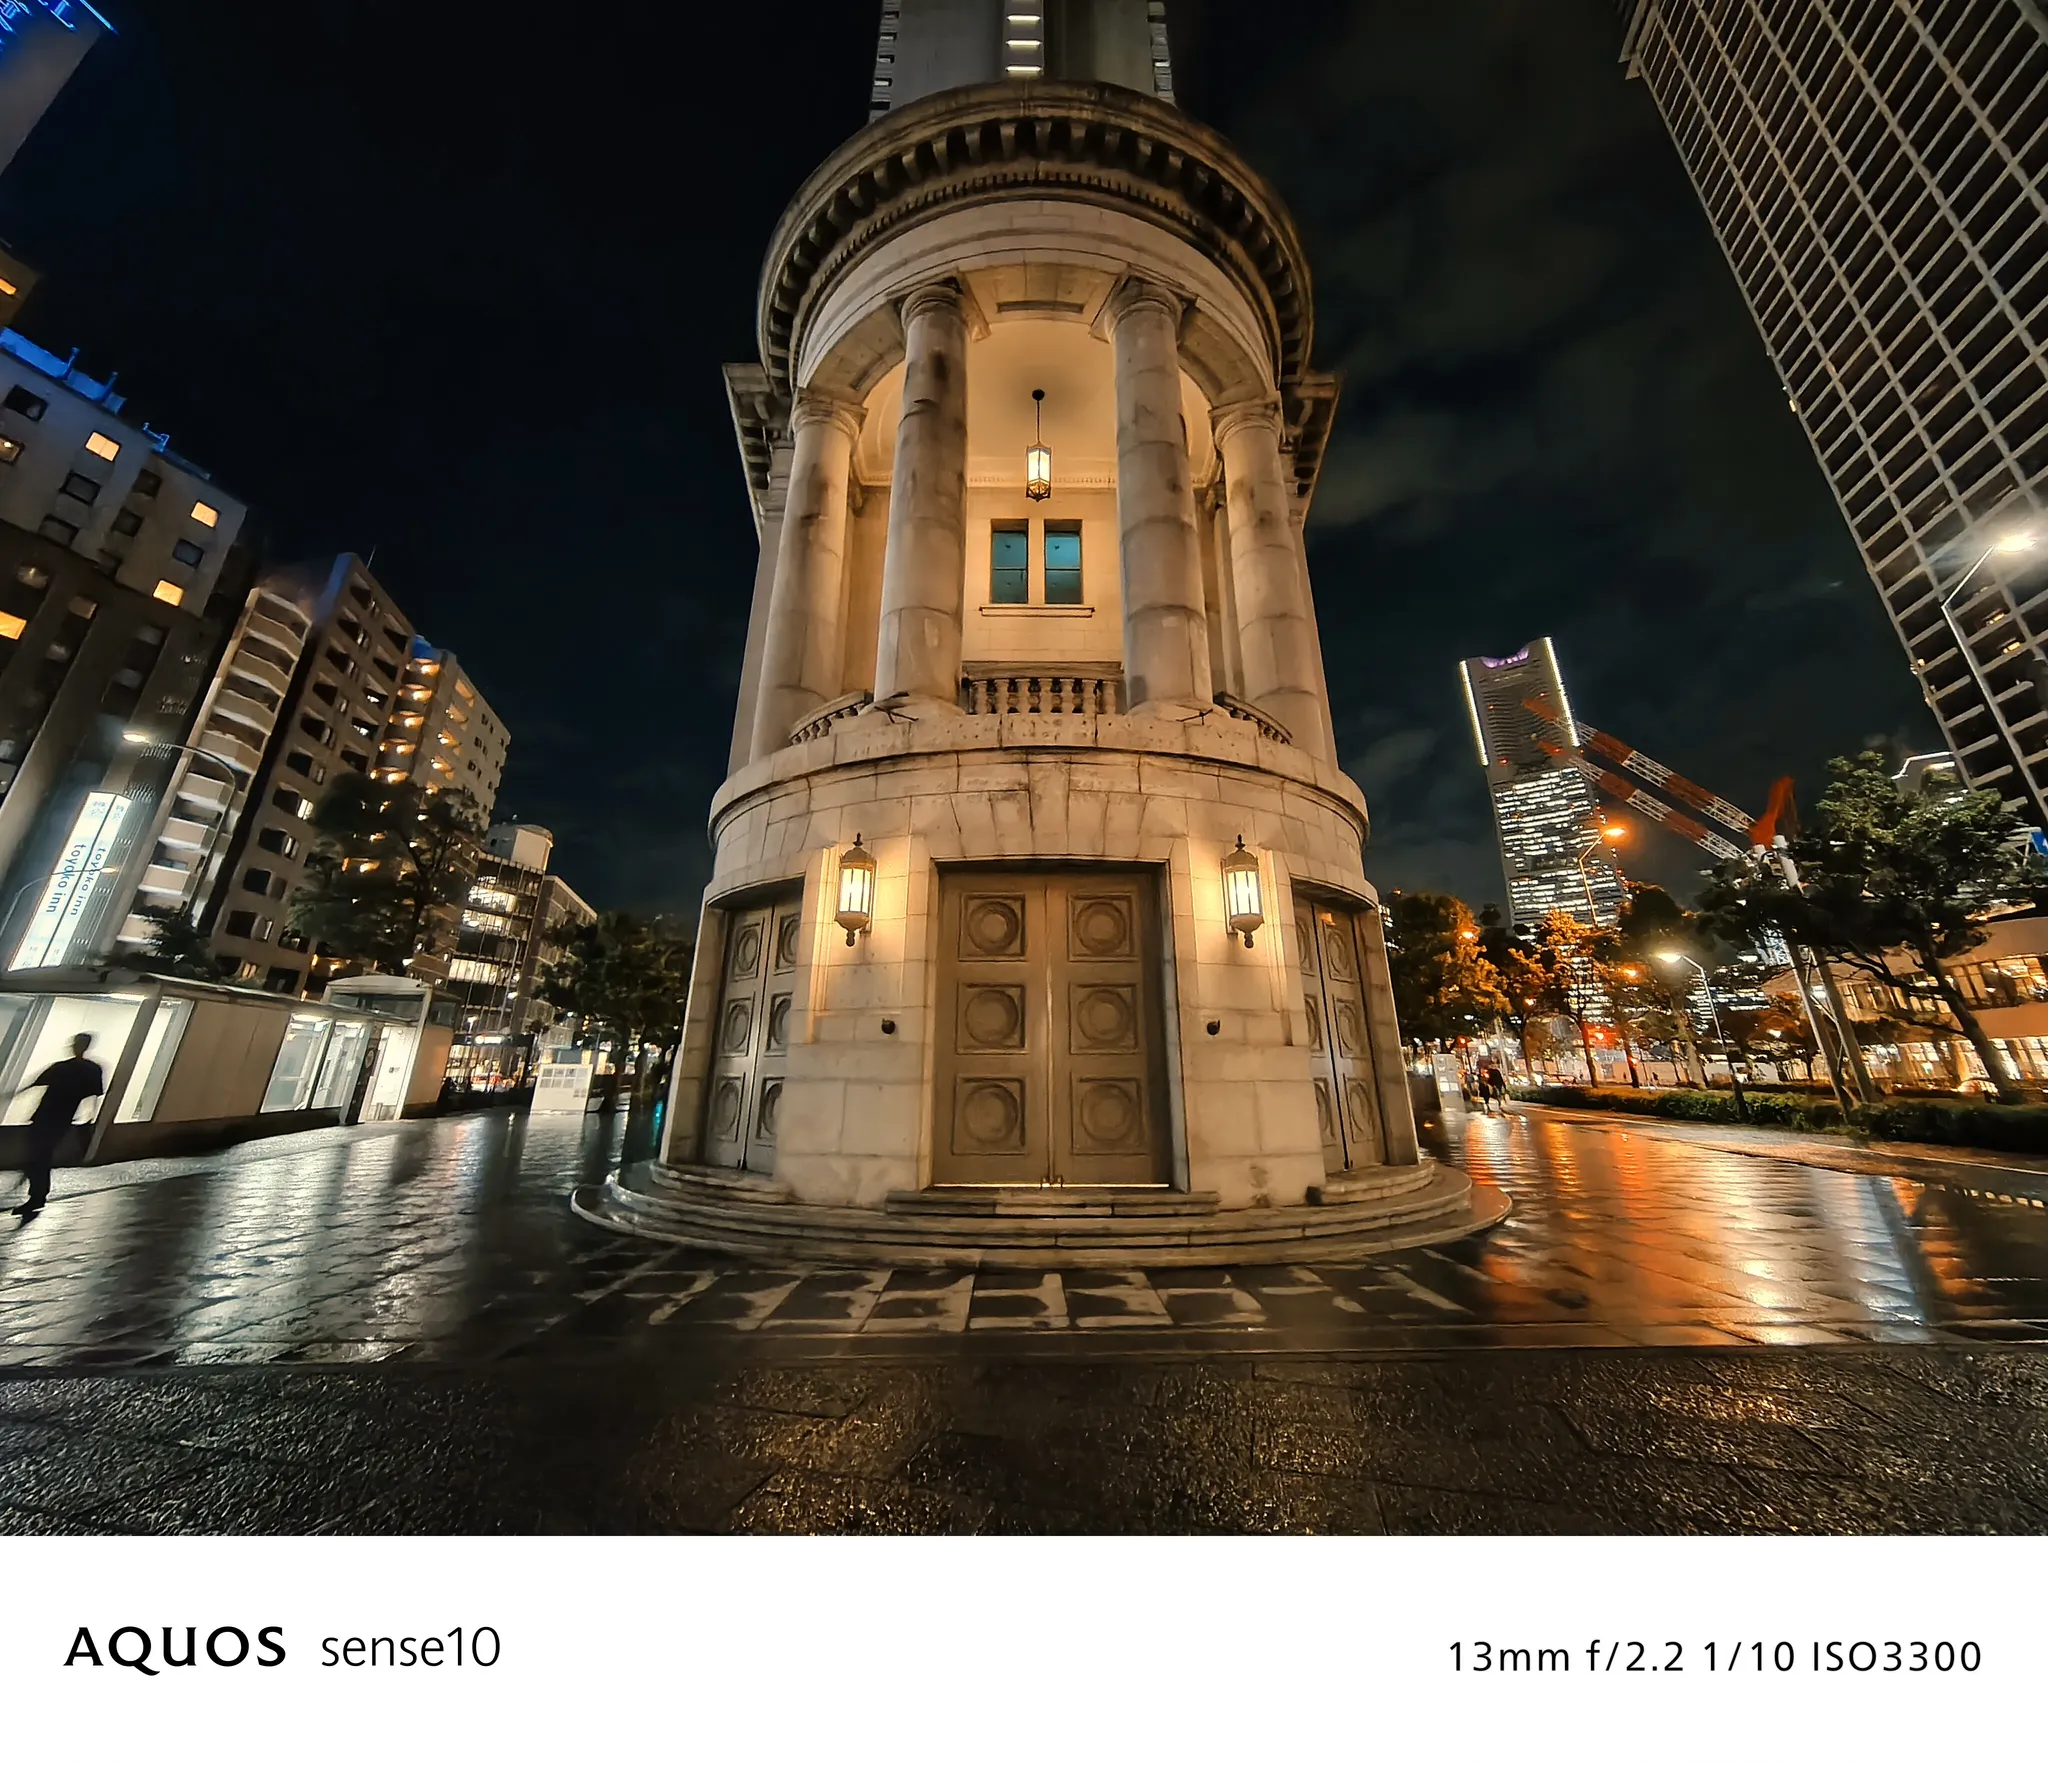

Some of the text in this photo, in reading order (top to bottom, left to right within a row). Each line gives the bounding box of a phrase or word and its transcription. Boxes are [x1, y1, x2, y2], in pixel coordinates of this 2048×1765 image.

[46, 844, 86, 913] toyoko inn
[71, 848, 106, 915] toyoko inn
